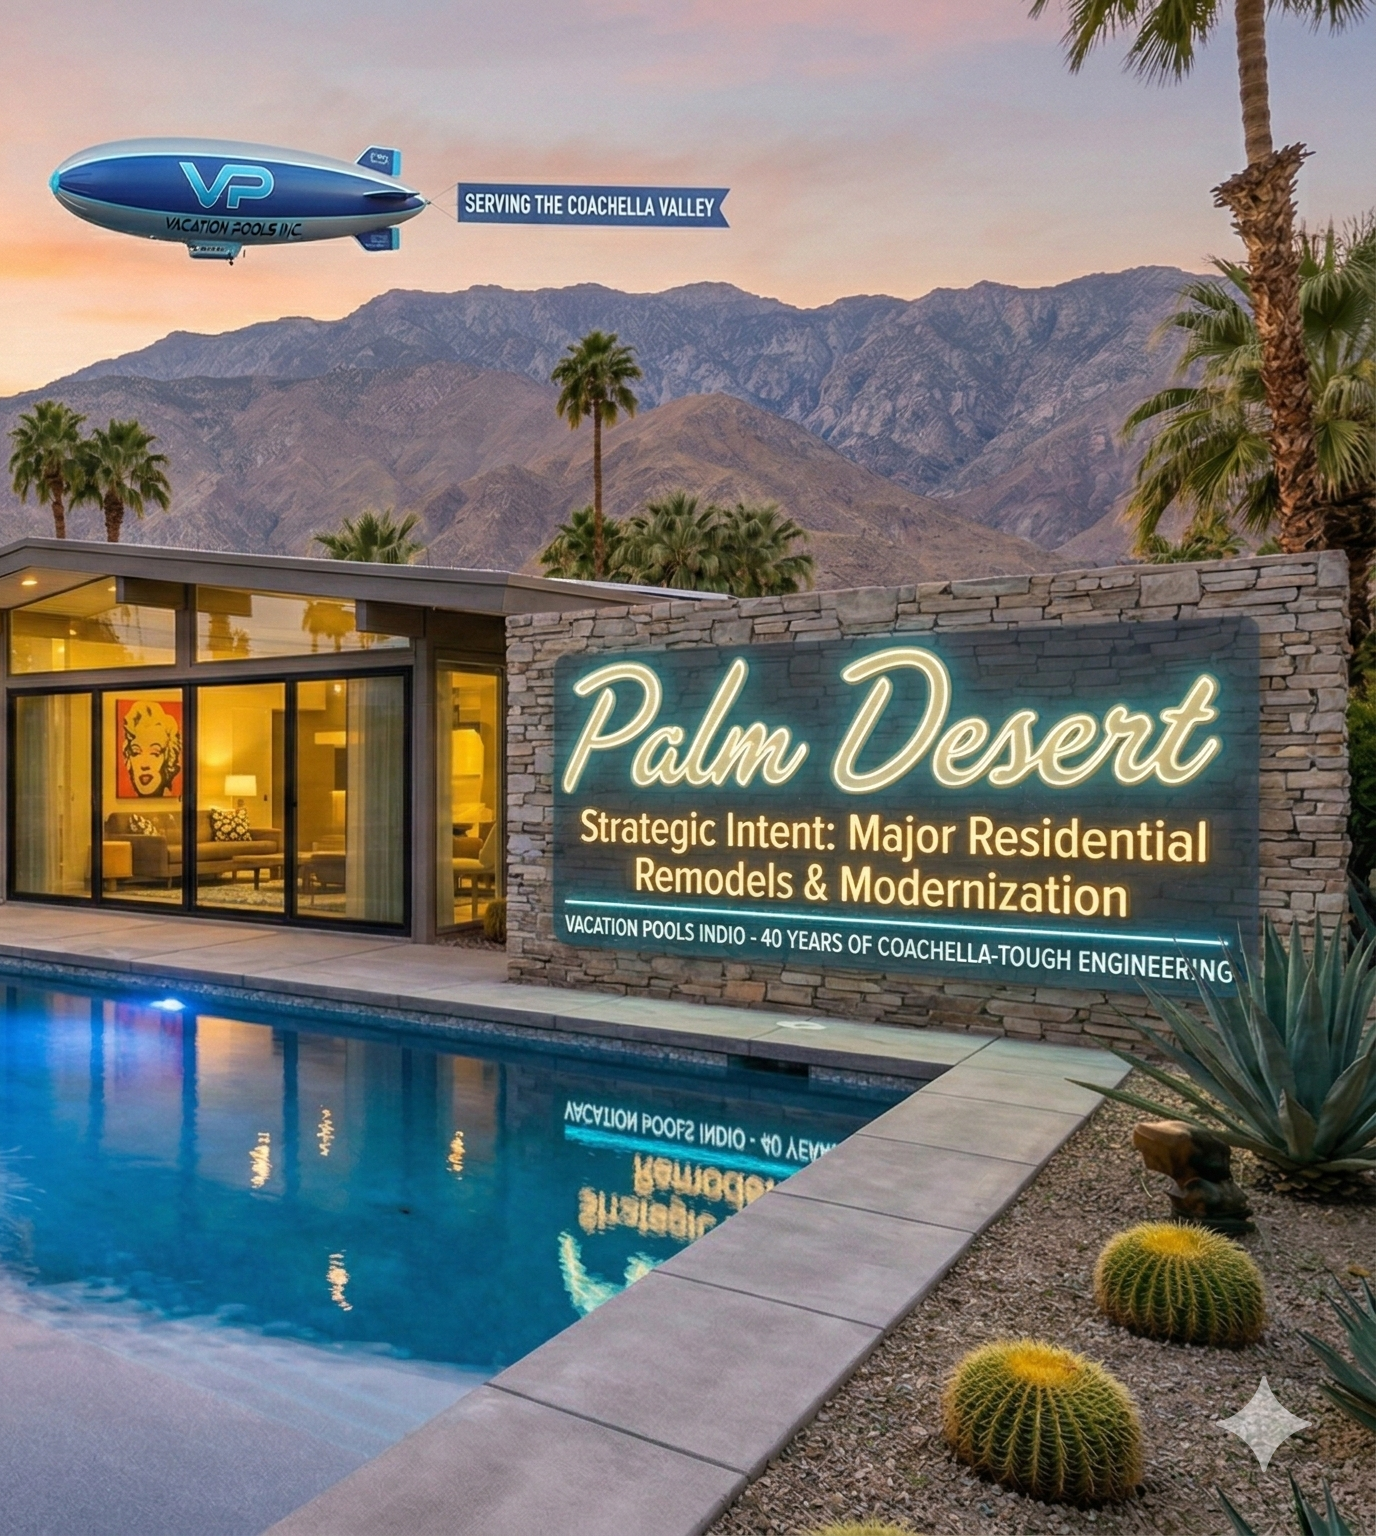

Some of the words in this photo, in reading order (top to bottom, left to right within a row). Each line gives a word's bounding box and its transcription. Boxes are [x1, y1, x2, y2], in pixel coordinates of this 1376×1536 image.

[179, 161, 274, 209] VP
[465, 193, 531, 214] SERVING
[535, 194, 563, 215] THE
[567, 195, 655, 216] COACHELLA
[659, 197, 715, 217] VALLEY
[166, 216, 230, 235] VACATION
[561, 656, 809, 794] Palm
[831, 646, 1221, 794] Desert
[581, 808, 716, 853] Strategic
[727, 812, 835, 850] Intent:
[849, 814, 956, 862] Major
[969, 816, 1206, 863] Residential
[636, 857, 793, 899] Remodels
[804, 863, 828, 901] &
[841, 866, 1127, 917] Modernization
[565, 914, 638, 937] VACATION
[642, 919, 694, 942] POOLS
[699, 924, 745, 945] INDIO
[761, 928, 782, 948] 40
[787, 930, 842, 953] YEARS
[848, 934, 872, 955] OF
[878, 936, 1072, 971] COACHELLA-TOUGH
